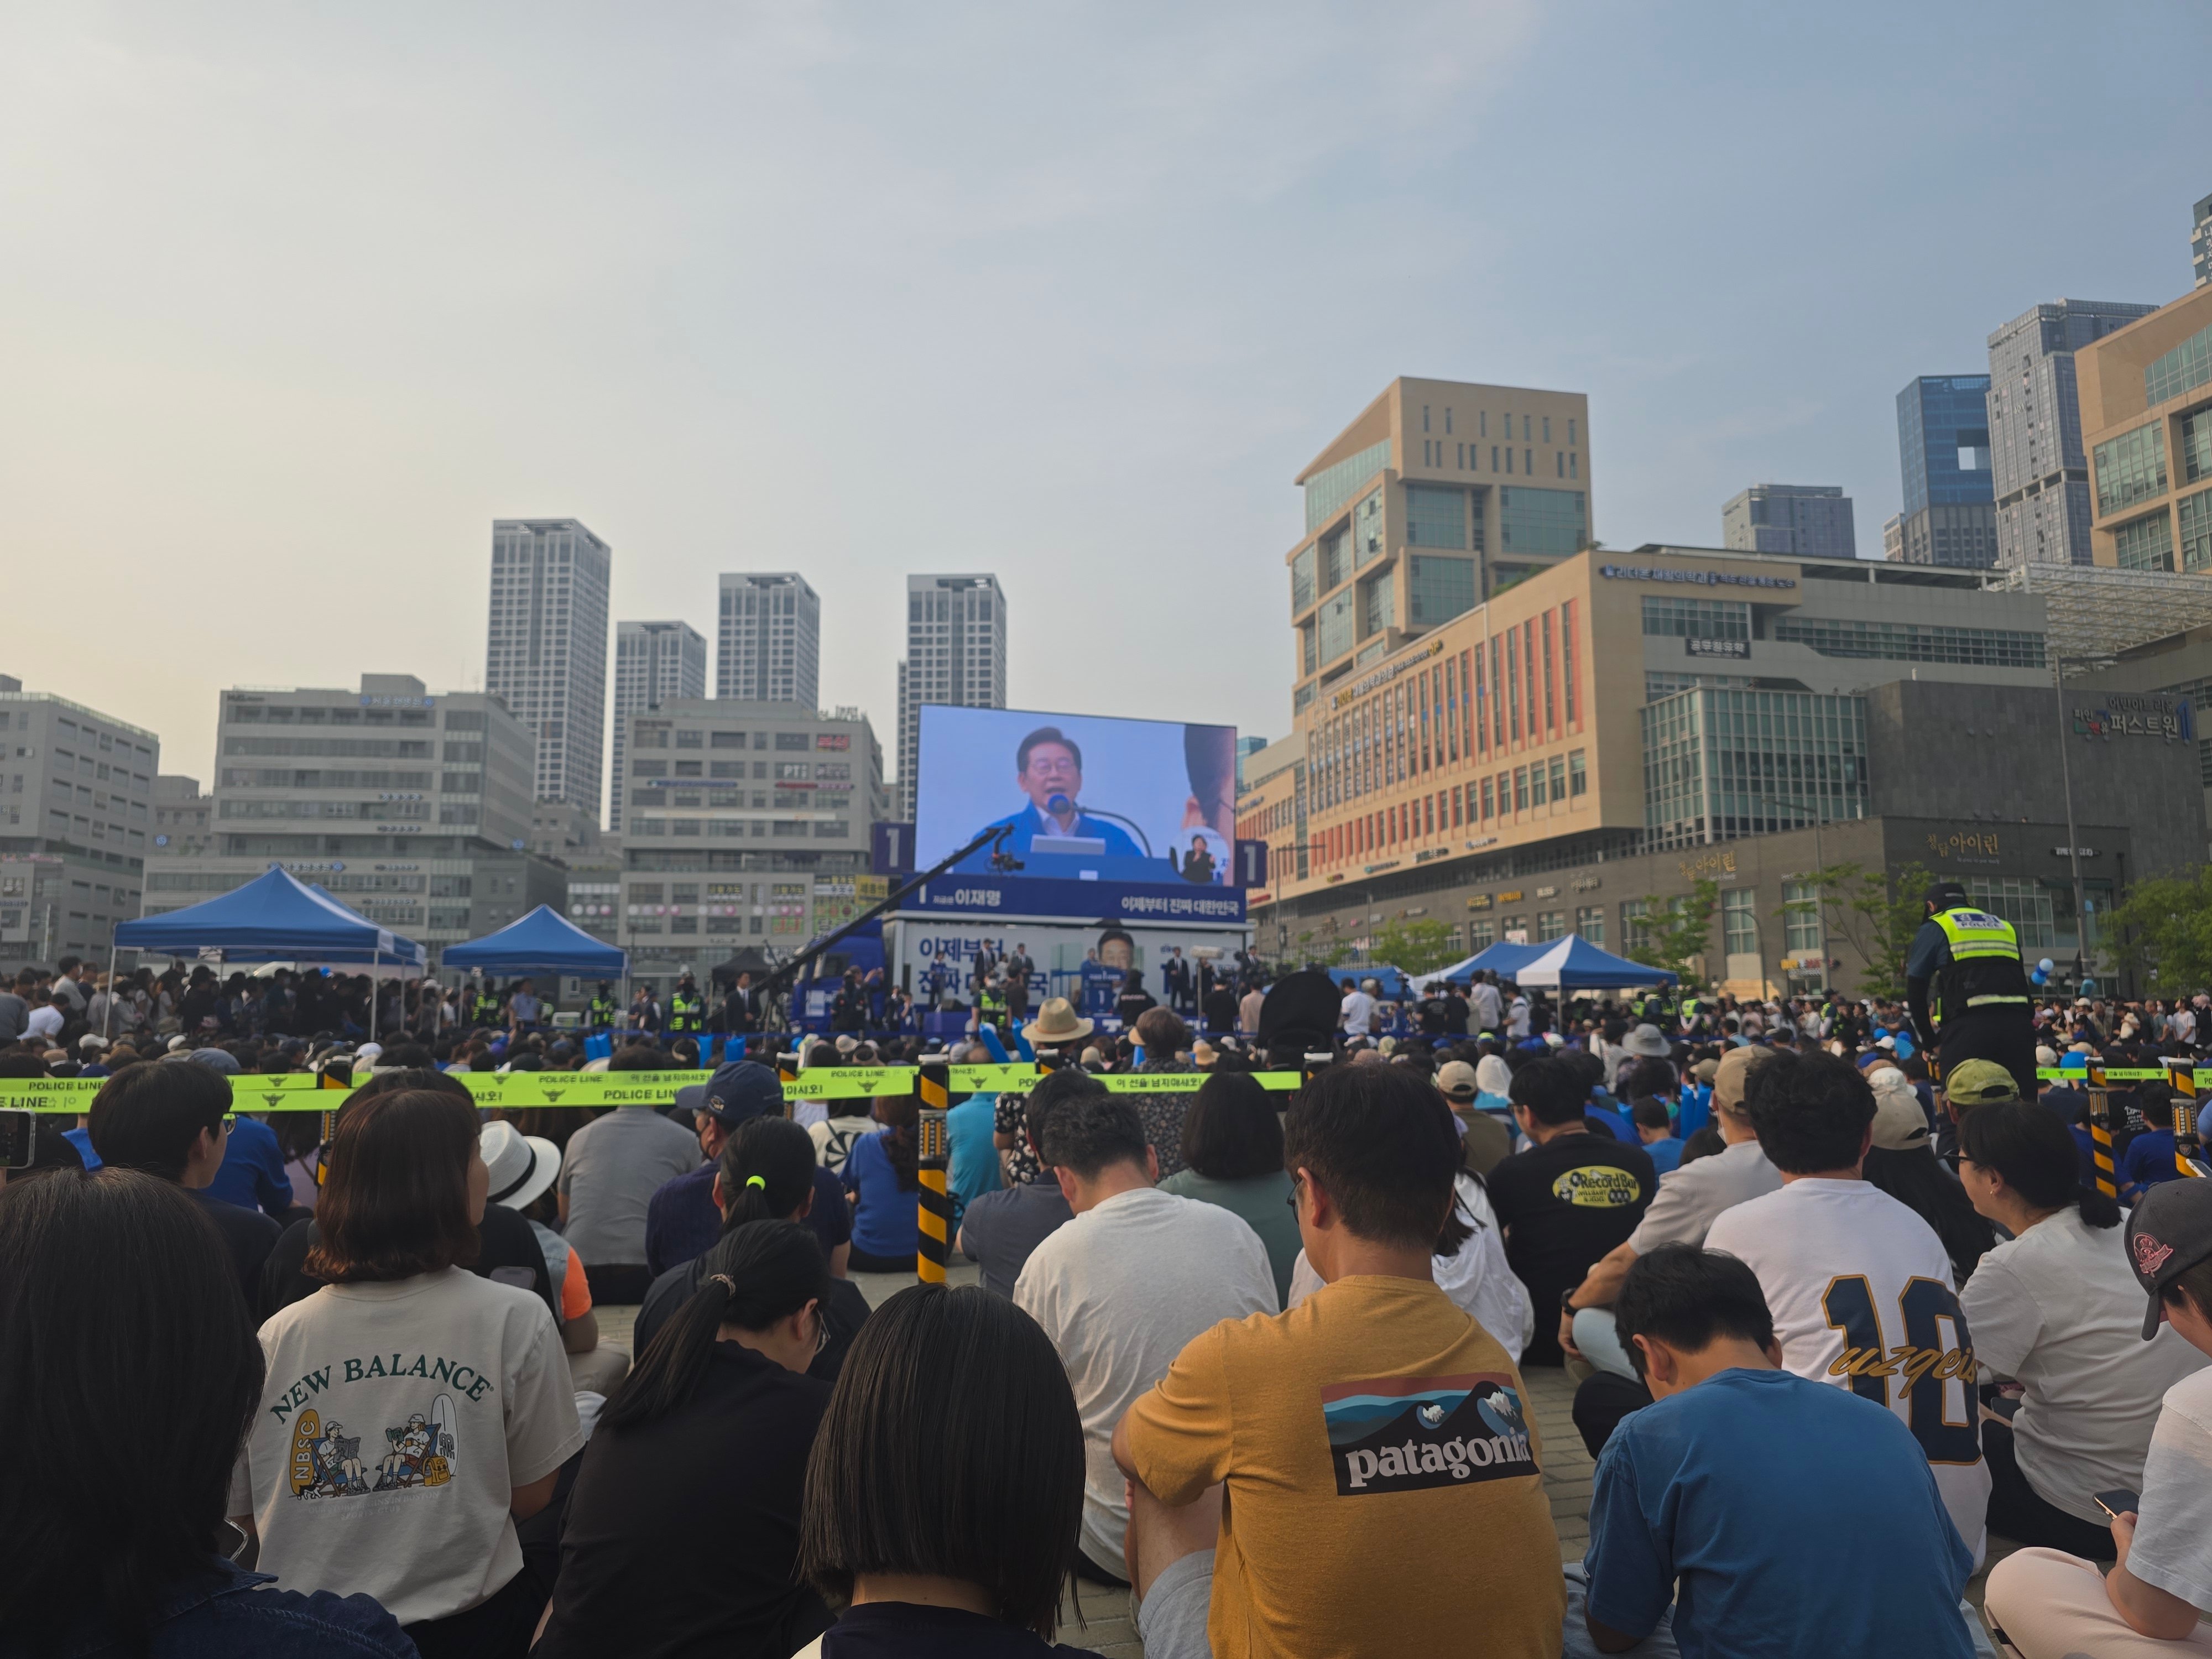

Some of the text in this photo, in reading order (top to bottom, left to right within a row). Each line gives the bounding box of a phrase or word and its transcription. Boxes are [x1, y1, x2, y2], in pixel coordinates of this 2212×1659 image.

[2110, 714, 2178, 738] 퍼스트원
[886, 828, 900, 868] 1
[1949, 831, 2000, 857] 아이린
[1244, 845, 1257, 882] 1
[954, 888, 1001, 907] 이재명
[1121, 896, 1239, 916] 이제부터 진짜 대한민국
[539, 1074, 576, 1084] POLICE
[580, 1074, 603, 1083] LINE
[831, 1070, 863, 1078] POLICE
[29, 1081, 74, 1091] POLICE
[603, 1089, 653, 1100] POLICE
[11, 1096, 48, 1108] LINE
[270, 1353, 491, 1425] NEW BALANCE
[294, 1420, 315, 1480] NBSC
[1345, 1426, 1532, 1488] patagonia
